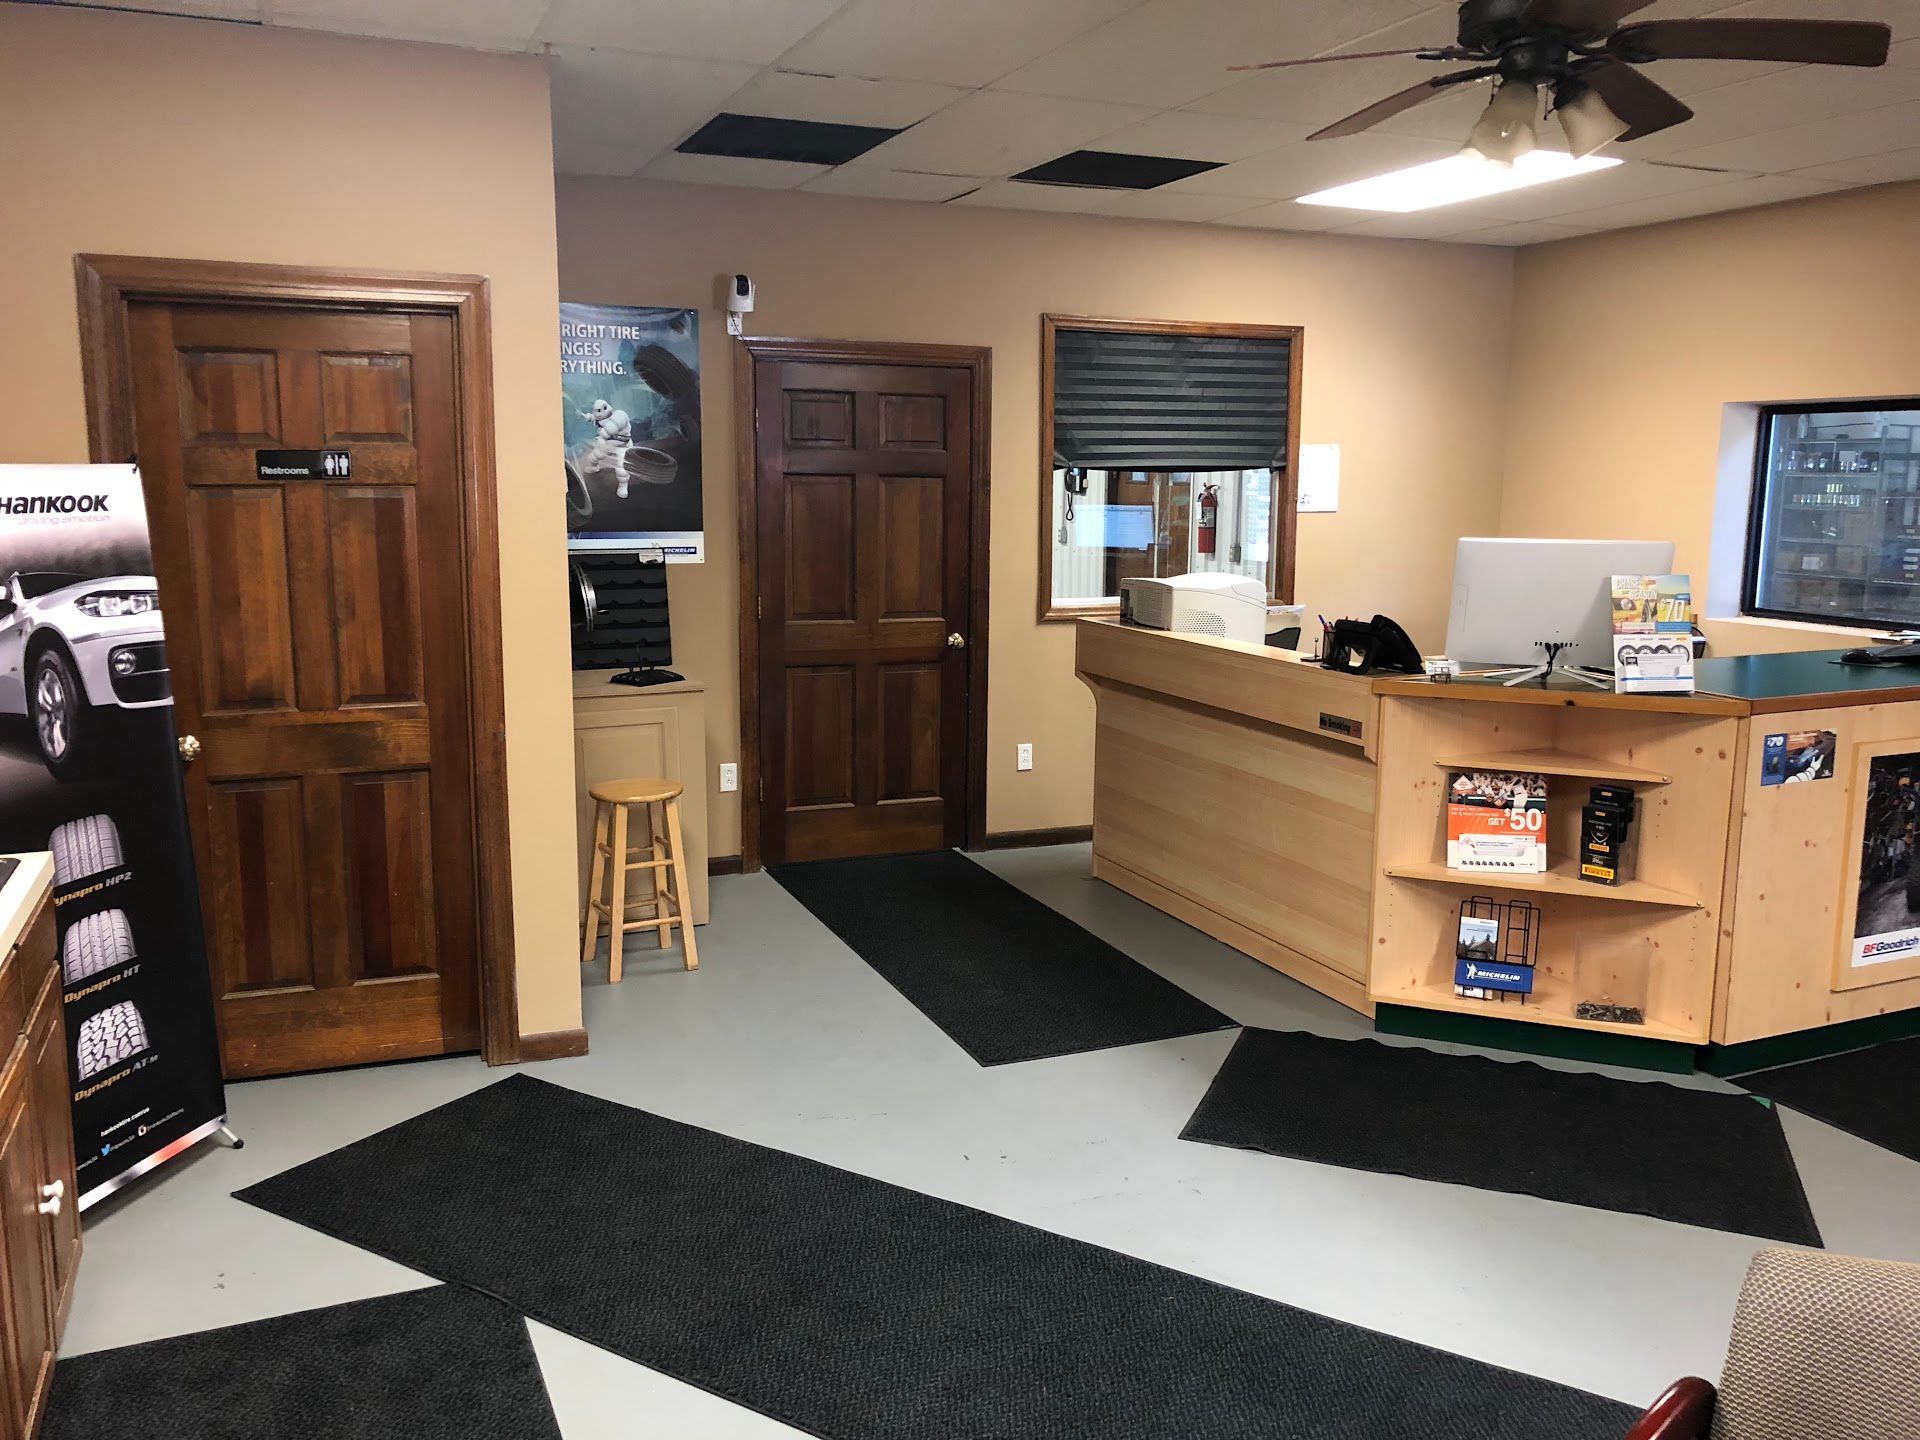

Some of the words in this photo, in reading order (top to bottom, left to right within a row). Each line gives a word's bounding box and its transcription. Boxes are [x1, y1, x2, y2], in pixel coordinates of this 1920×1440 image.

[561, 323, 605, 338] RIGHT
[609, 325, 640, 340] TIRE
[260, 466, 310, 475] Restrooms
[1660, 598, 1685, 622] $70
[1328, 717, 1351, 735] Smoking
[1487, 817, 1506, 826] GET
[105, 871, 132, 888] HP2
[1863, 936, 1919, 954] BFGoodrich
[64, 974, 121, 1004] Dynapro
[123, 964, 141, 978] HT
[1477, 970, 1521, 981] MICHELIN
[75, 1068, 131, 1102] Dynapro
